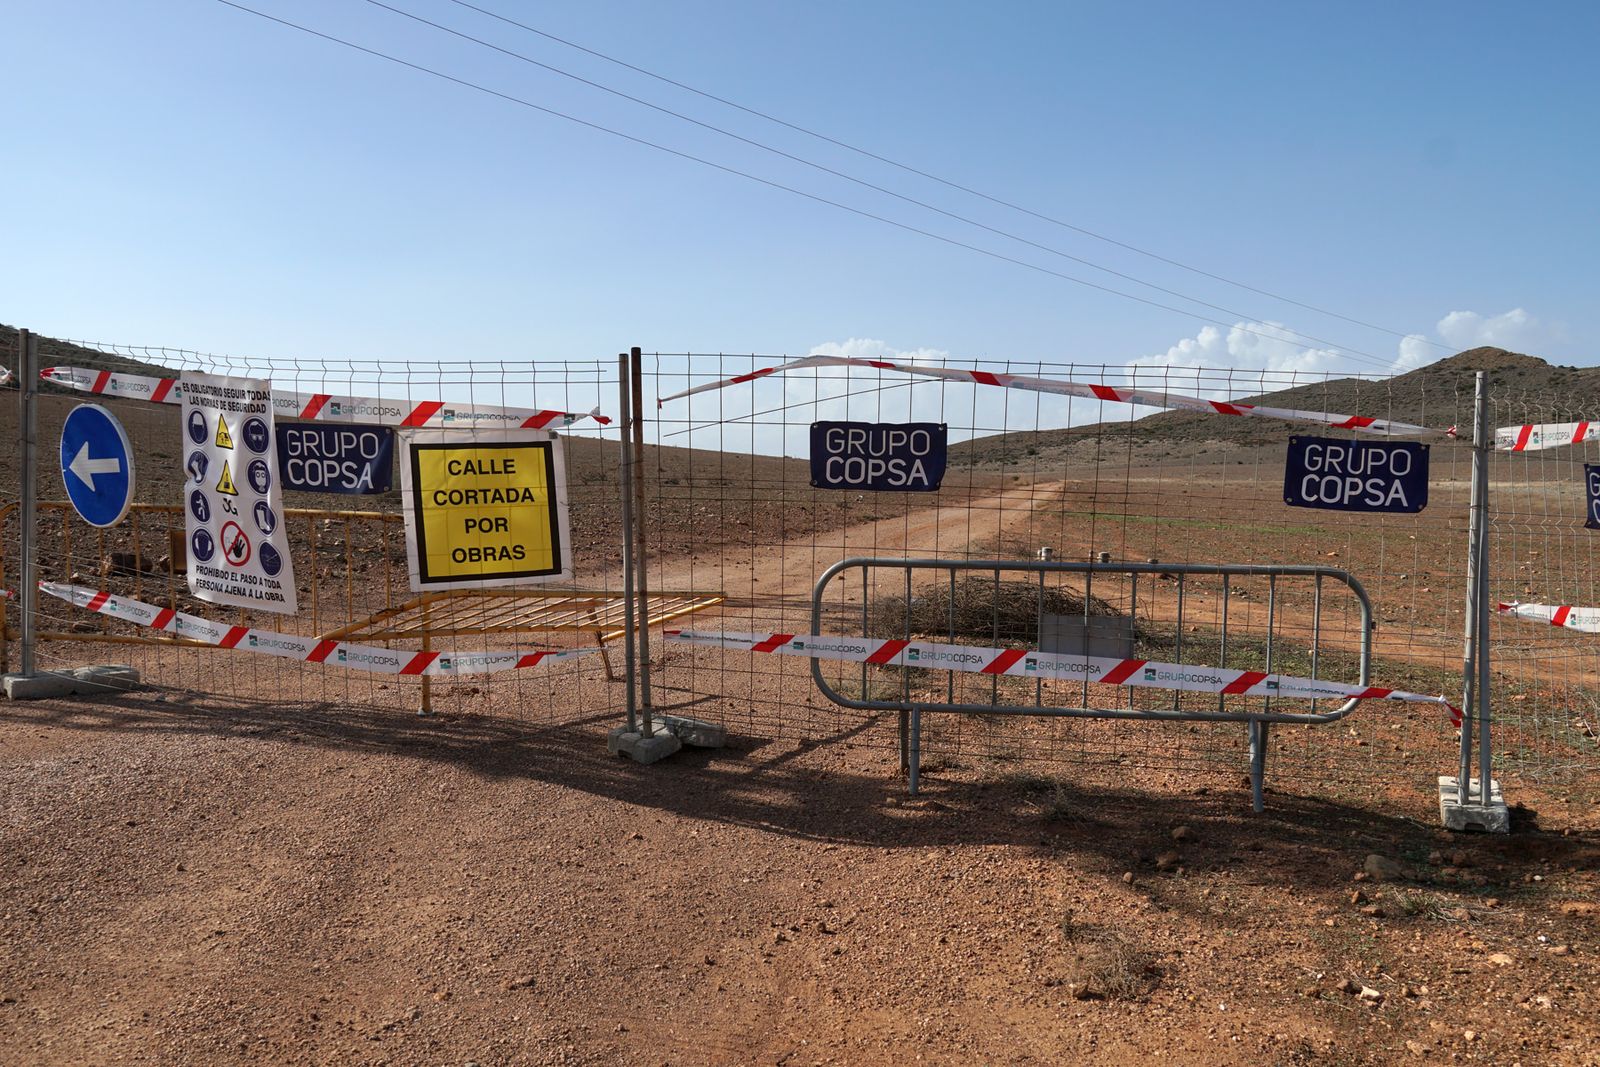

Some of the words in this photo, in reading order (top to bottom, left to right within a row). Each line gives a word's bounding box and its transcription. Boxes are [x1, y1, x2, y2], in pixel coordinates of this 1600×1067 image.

[182, 382, 190, 393] ES
[190, 383, 223, 398] OBLIGATORIO
[223, 388, 246, 400] SEGUIR
[247, 389, 271, 402] TODAS
[189, 395, 200, 406] LAS
[220, 400, 227, 411] DE
[227, 401, 267, 414] SEGURIDAD
[342, 405, 401, 417] GRUPOCOPSA
[286, 430, 379, 459] GRUPO
[826, 428, 931, 456] GRUPO
[447, 459, 516, 476] CALLE
[1304, 444, 1412, 476] GRUPO
[287, 458, 375, 490] COPSA
[825, 456, 928, 487] COPSA
[433, 487, 535, 506] CORTADA
[1300, 474, 1408, 507] COPSA
[464, 517, 509, 534] POR
[452, 545, 526, 563] OBRAS
[230, 571, 239, 582] EL
[240, 573, 258, 585] PASO
[259, 578, 264, 587] A
[264, 578, 282, 590] TODA
[195, 578, 223, 594] PERSONA
[224, 584, 247, 598] AJENA
[248, 588, 254, 599] A
[255, 589, 264, 600] LA
[264, 591, 286, 604] OBRA
[258, 637, 307, 653] GRUPOCOPSA
[347, 651, 400, 667] GRUPOCOPSA
[921, 650, 983, 665] GRUPOCOPSA
[1038, 661, 1101, 675] GRUPOCOPSA
[1157, 670, 1223, 686] GRUPOCOPSA
